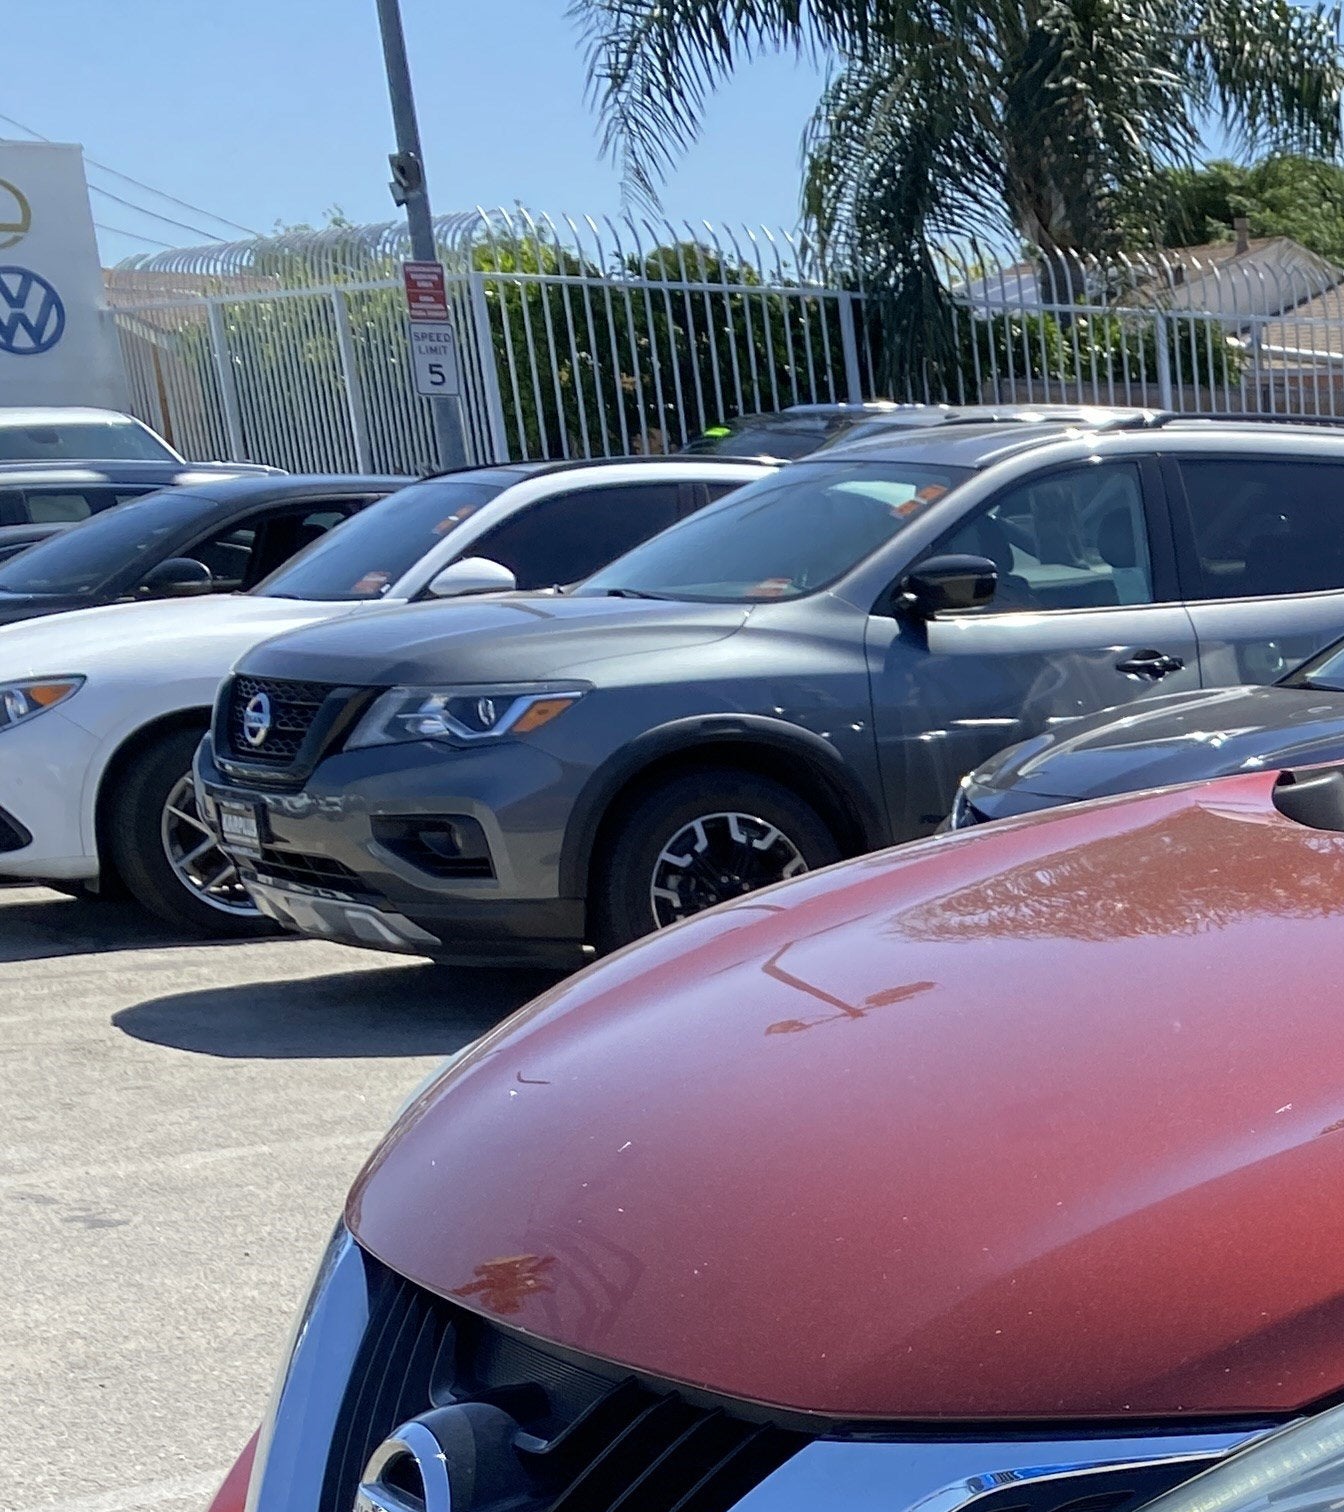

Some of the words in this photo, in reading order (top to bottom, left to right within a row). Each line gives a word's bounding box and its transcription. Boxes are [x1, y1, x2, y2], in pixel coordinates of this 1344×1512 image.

[413, 332, 451, 342] SPEED
[418, 345, 447, 355] LIMIT
[429, 364, 446, 386] 5
